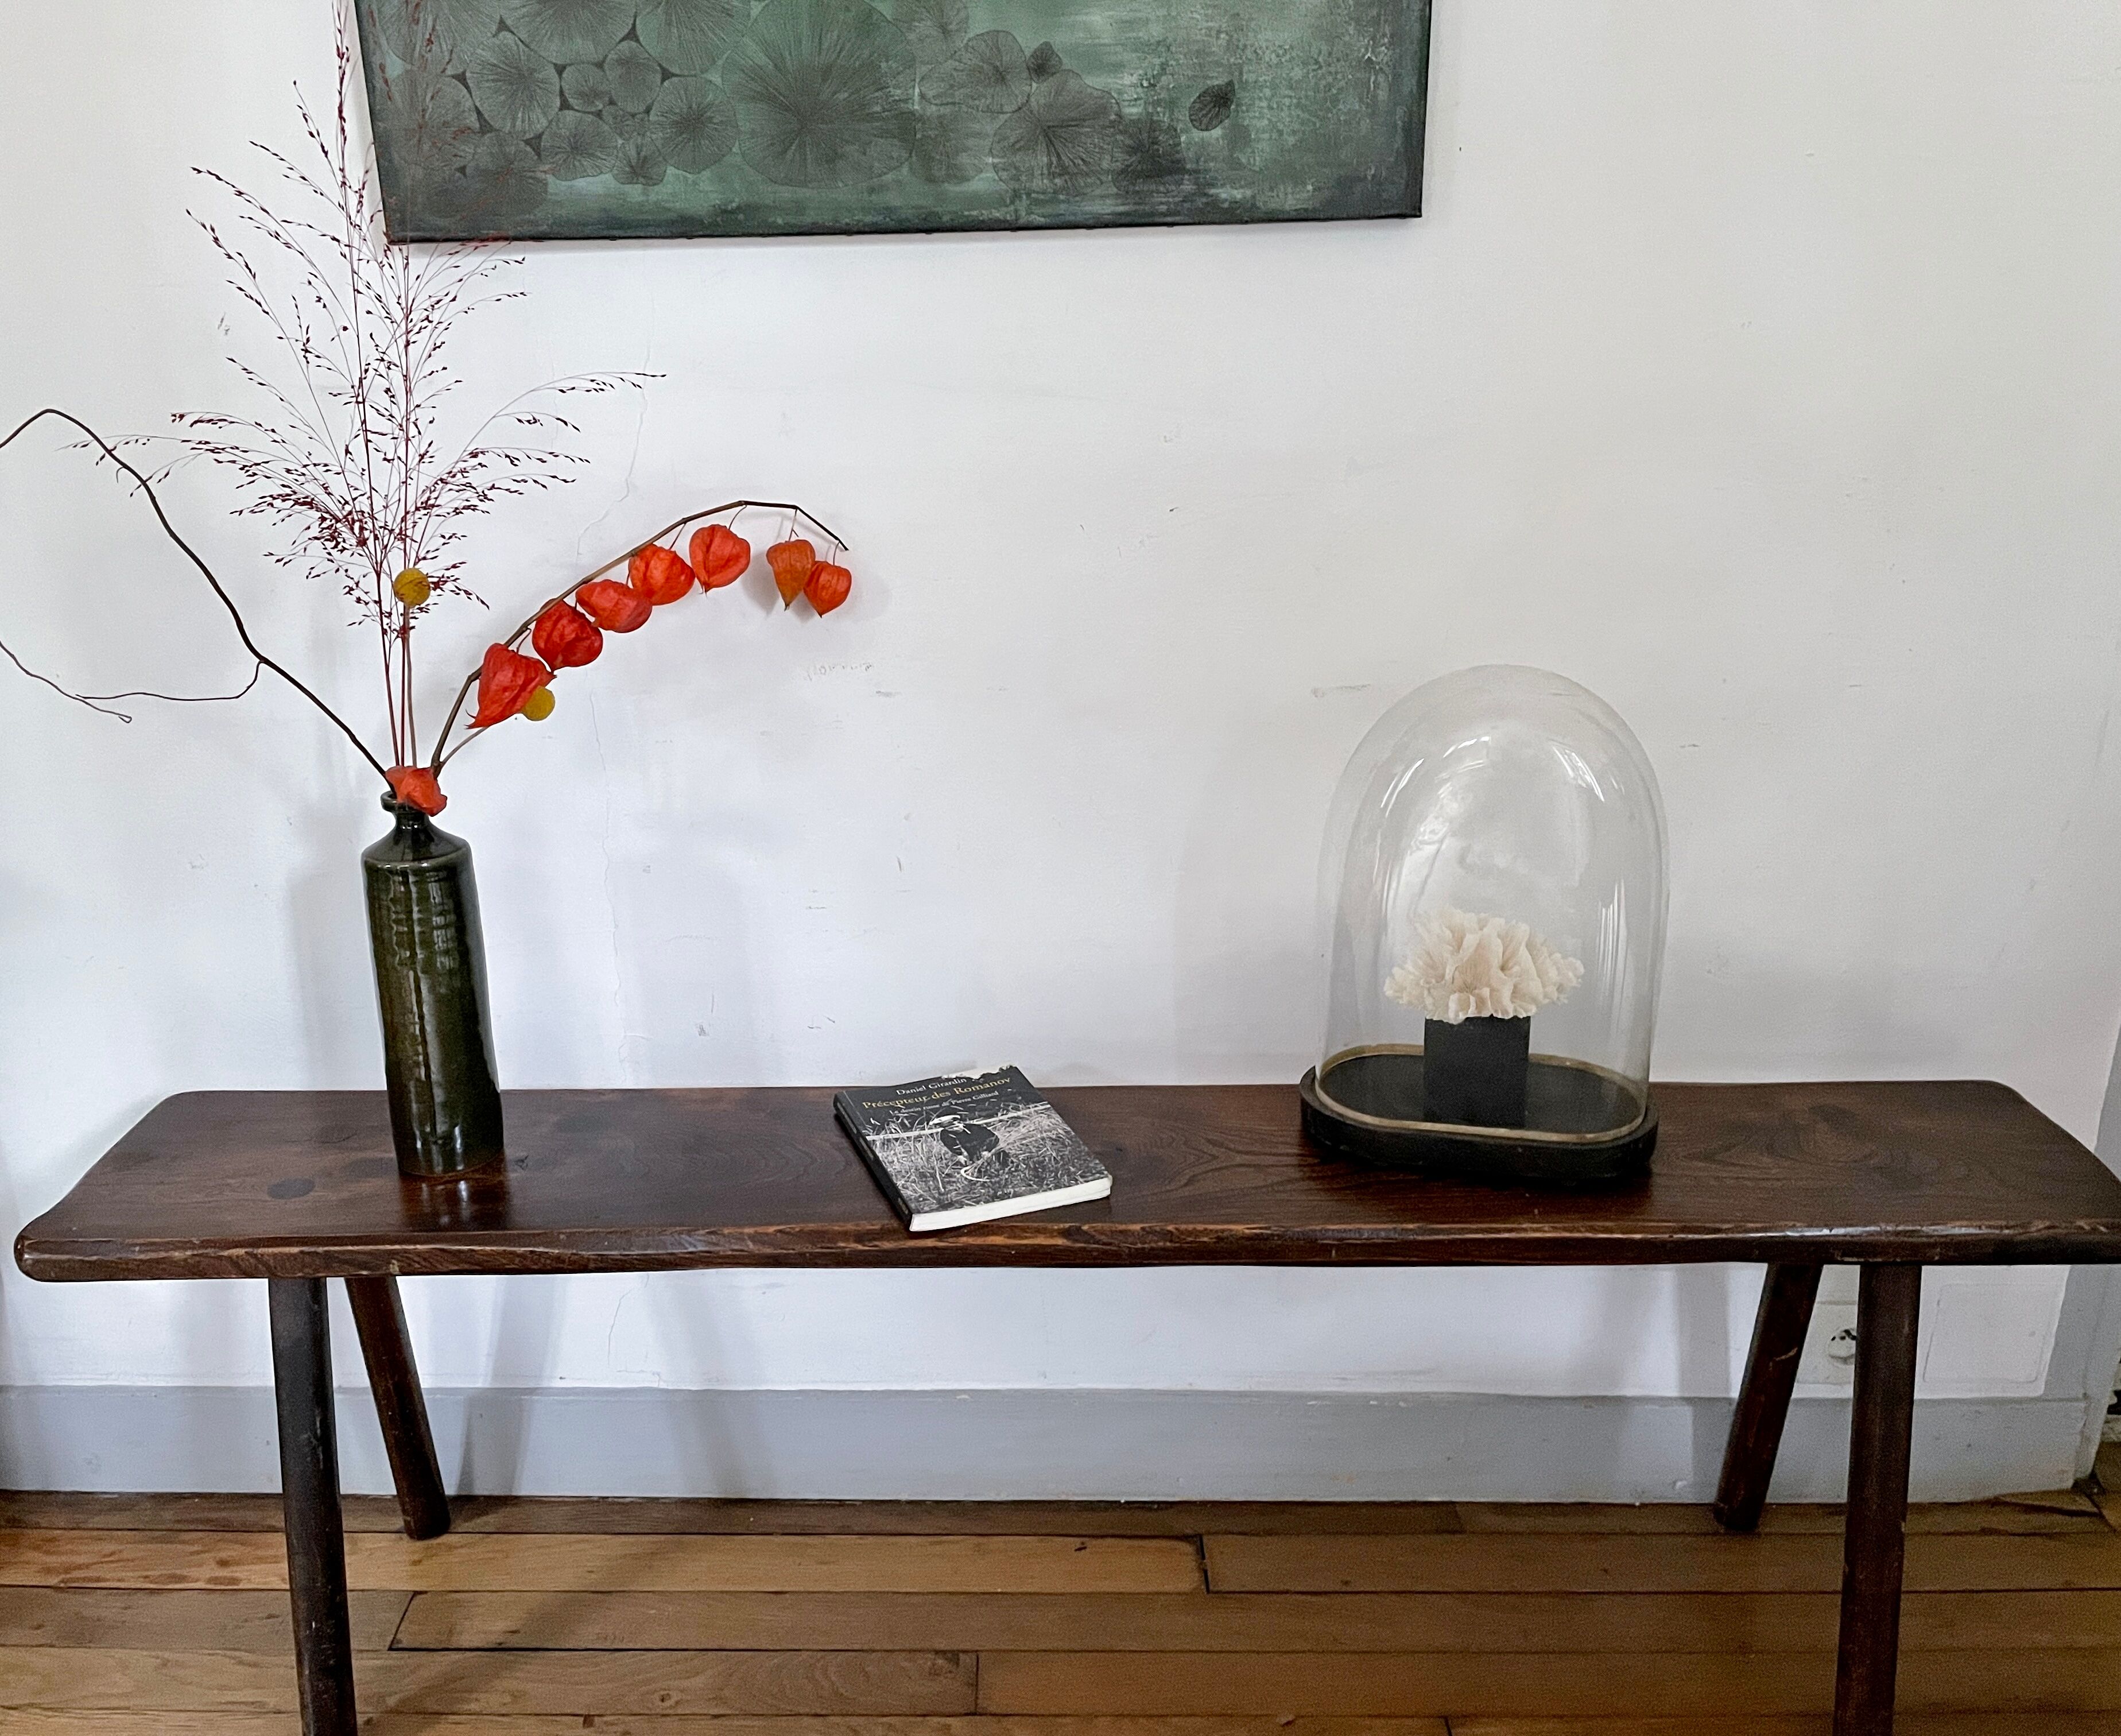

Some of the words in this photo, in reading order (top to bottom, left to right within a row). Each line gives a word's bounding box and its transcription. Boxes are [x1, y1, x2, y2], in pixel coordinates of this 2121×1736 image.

[862, 1096, 930, 1109] Précepteur
[931, 1091, 951, 1099] des
[953, 1077, 1010, 1094] Romanov
[896, 1085, 926, 1095] Daniel
[928, 1078, 967, 1089] Girardin
